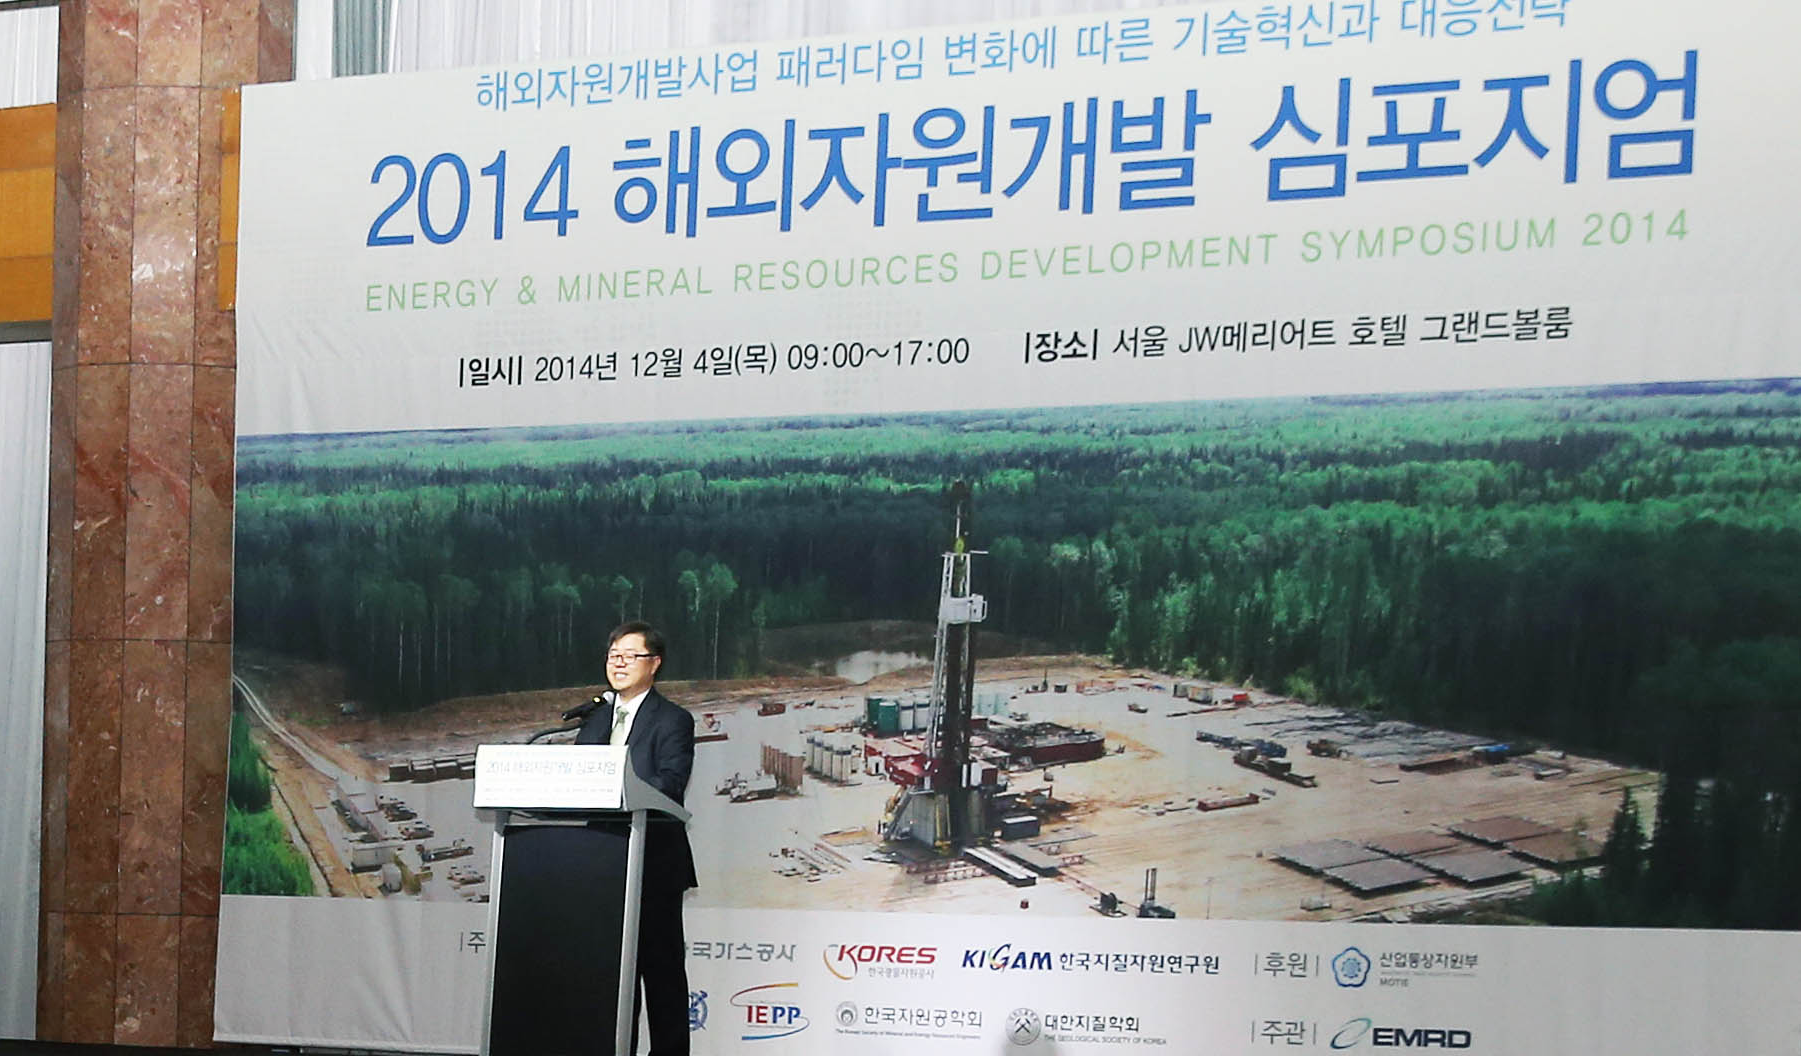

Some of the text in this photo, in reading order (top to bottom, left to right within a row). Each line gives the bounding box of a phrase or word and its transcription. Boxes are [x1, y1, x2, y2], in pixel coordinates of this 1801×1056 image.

[476, 49, 758, 112] 해외자원개발사업
[775, 36, 925, 88] 패러다임
[944, 25, 1057, 77] 변화에
[1076, 17, 1154, 65] 따른
[1173, 0, 1380, 57] 기술혁신과
[365, 48, 1700, 249] 2014 해외자원개발 심포지엄
[366, 208, 1689, 312] ENERGY & MINERAL RESOURCES DEVELOPMENT SYMPOSIUM 2014
[1112, 323, 1169, 359] 서울
[1178, 318, 1336, 354] JW메리어트
[1347, 313, 1407, 347] 호텔
[1419, 305, 1574, 344] 그랜드볼룸
[534, 351, 618, 382] 2014년
[631, 347, 683, 379] 12월
[693, 342, 777, 376] 4일(목)
[787, 337, 971, 371] 09:00~17:00
[685, 940, 798, 962] 국가스공사
[838, 944, 938, 972] KORES
[961, 943, 1220, 975] KIGAM 한국지질자원연구원
[747, 1005, 801, 1025] IEPP
[864, 1006, 982, 1028] 한국자원공학회
[1044, 1014, 1140, 1032] 대한지질학회
[1372, 1027, 1472, 1049] EMRD
